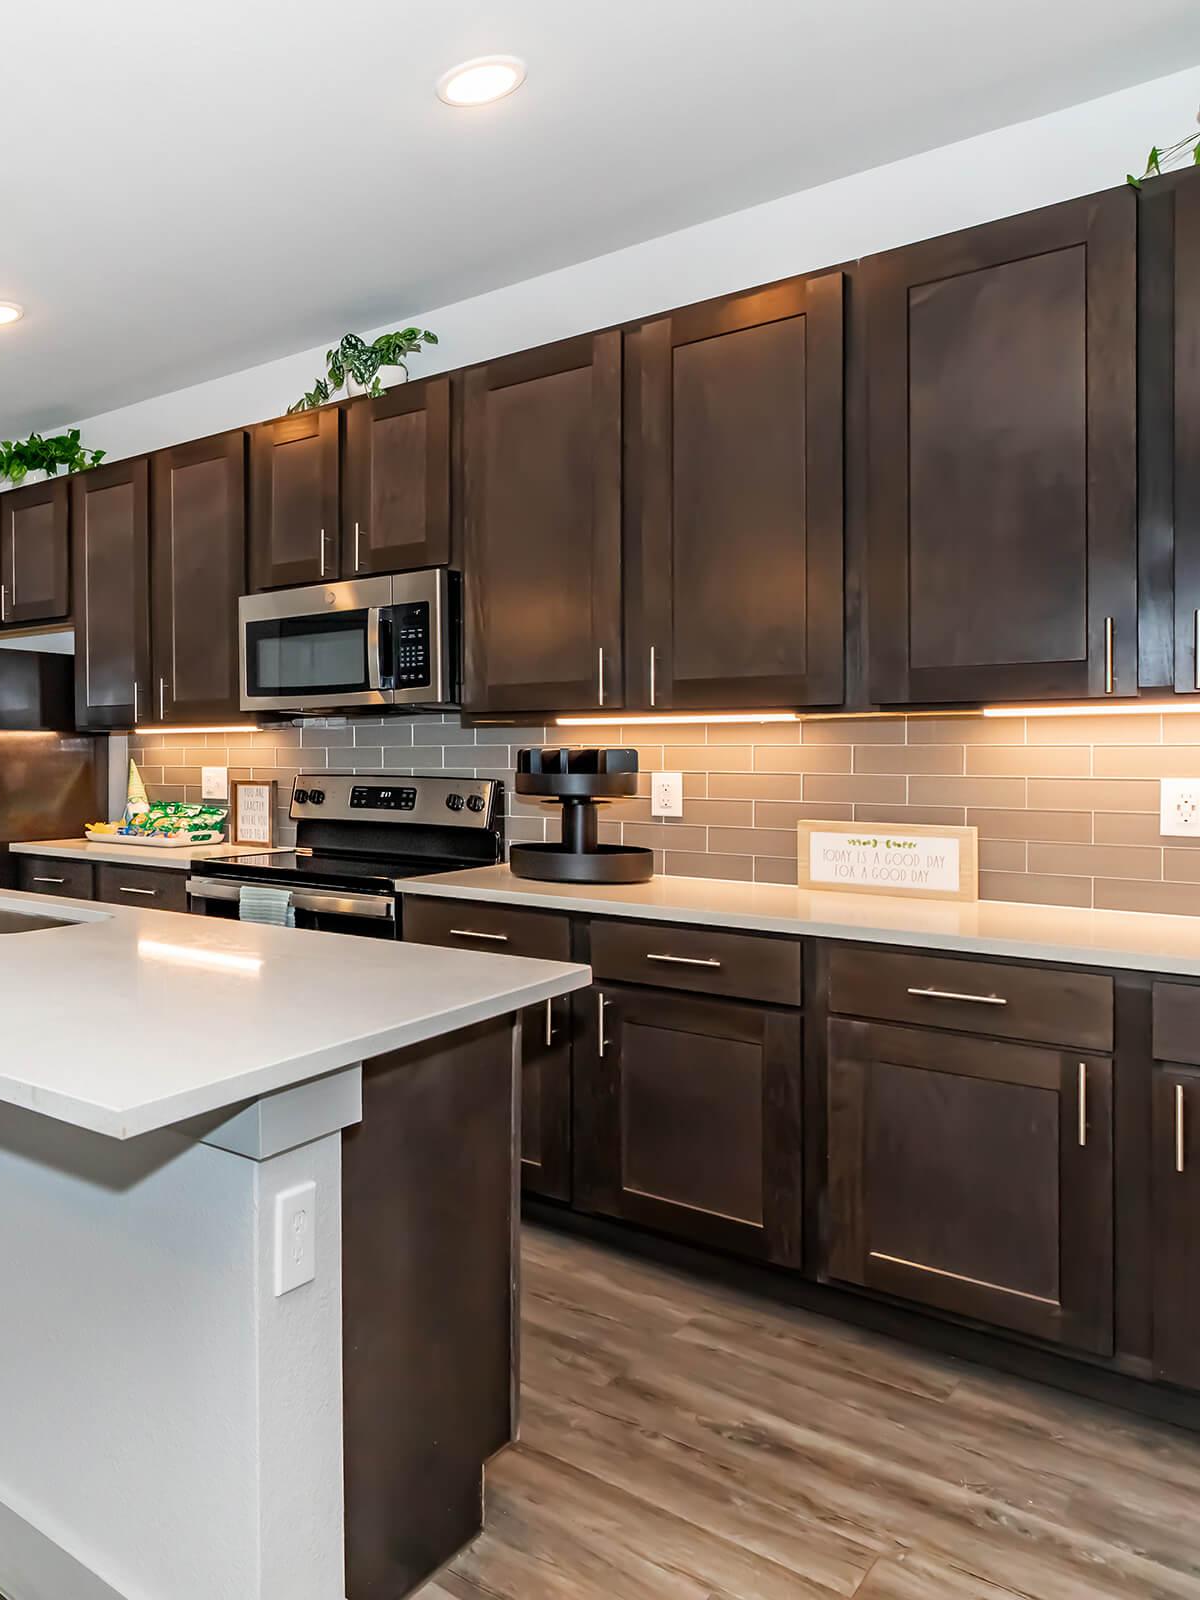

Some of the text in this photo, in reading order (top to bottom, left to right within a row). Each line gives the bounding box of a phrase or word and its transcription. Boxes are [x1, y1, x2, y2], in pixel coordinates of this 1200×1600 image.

[823, 848, 945, 869] TODAY IS A GOOD DAY
[834, 864, 929, 883] FOR A GOOD DAY
